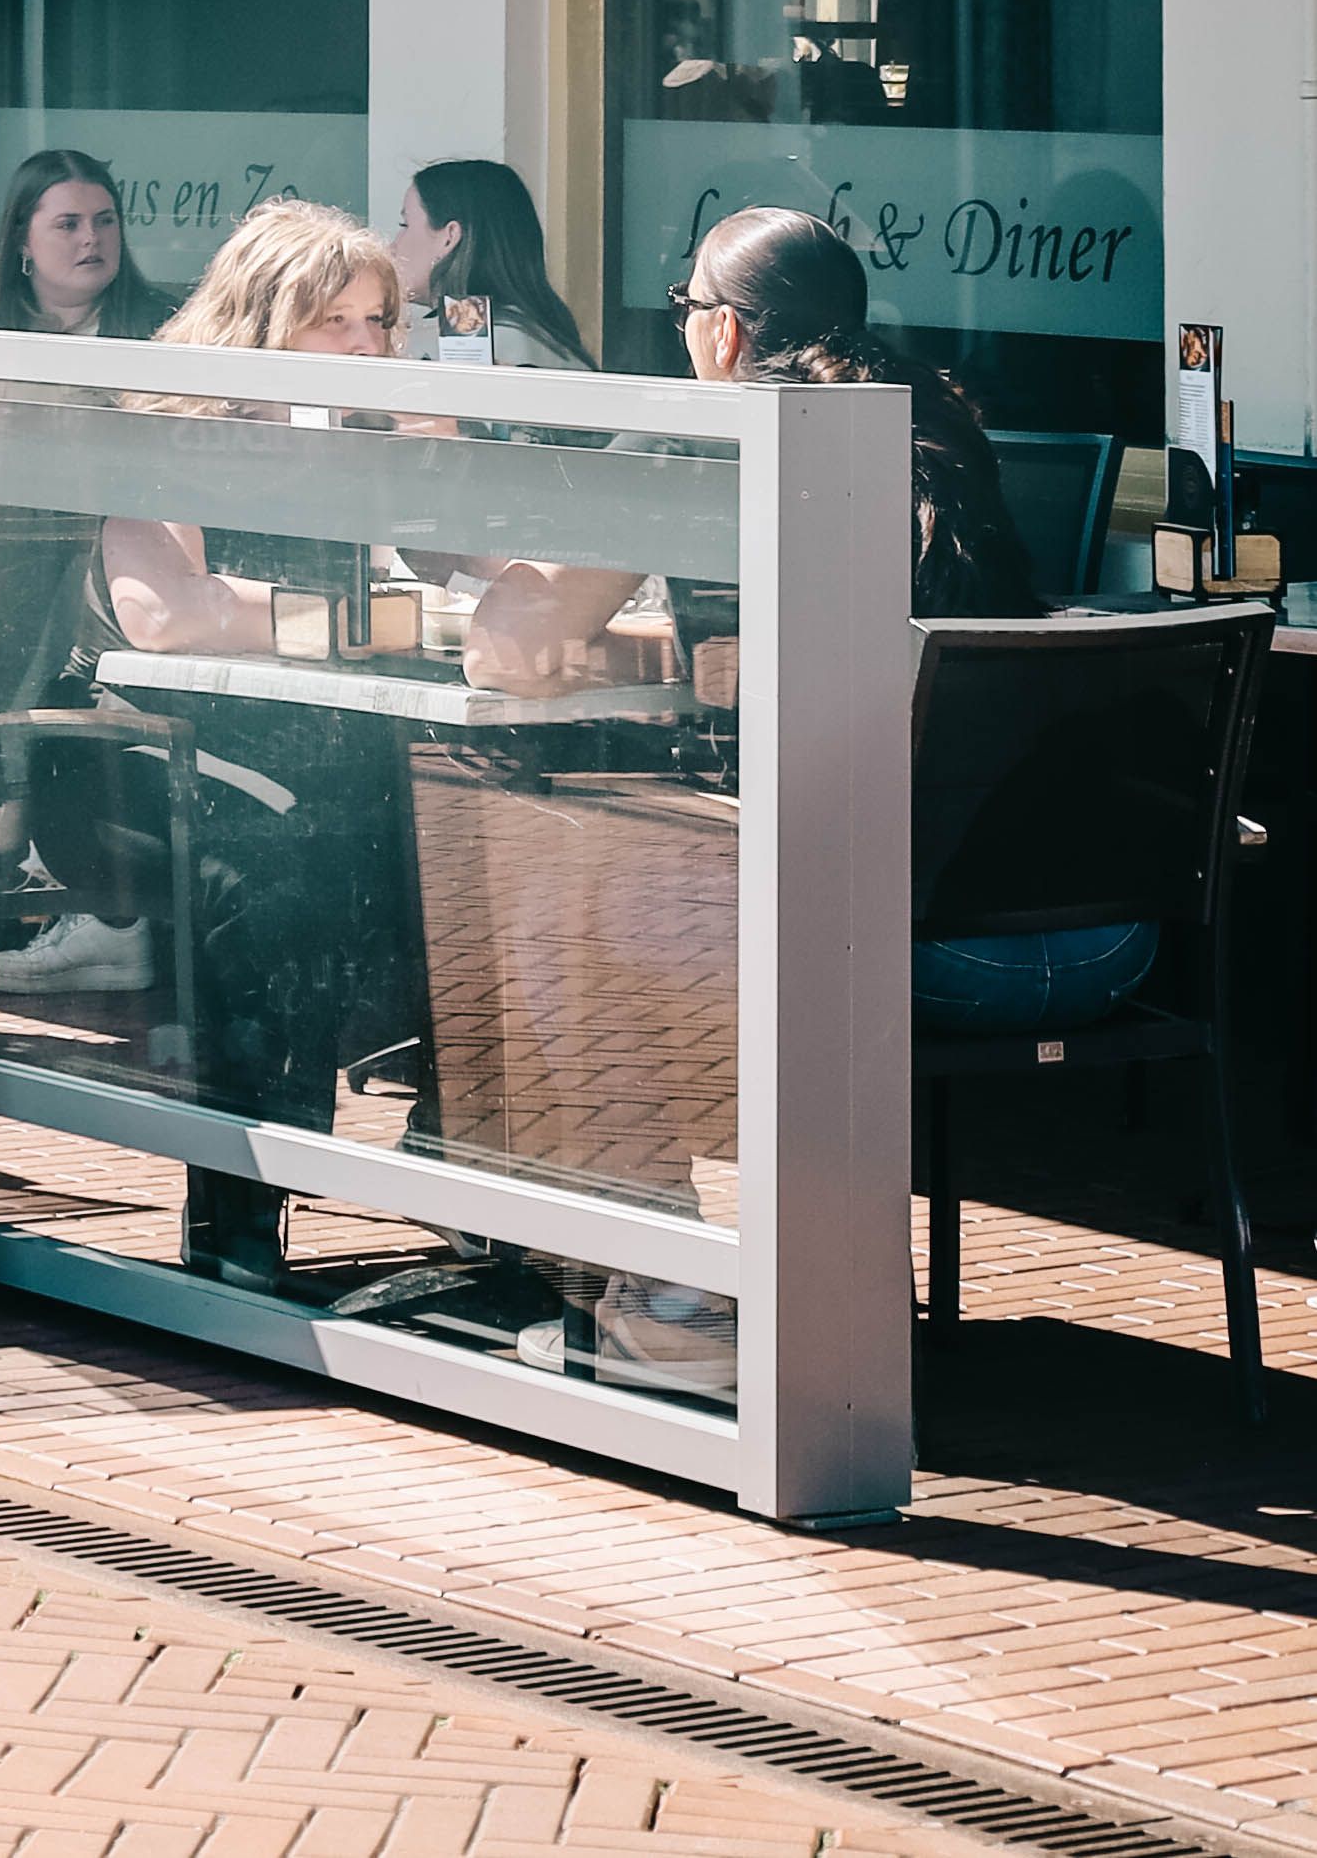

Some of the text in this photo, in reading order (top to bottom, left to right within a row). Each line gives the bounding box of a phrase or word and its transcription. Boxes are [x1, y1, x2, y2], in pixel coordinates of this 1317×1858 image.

[173, 181, 224, 228] en
[869, 202, 924, 271] &
[944, 197, 1133, 283] Diner
